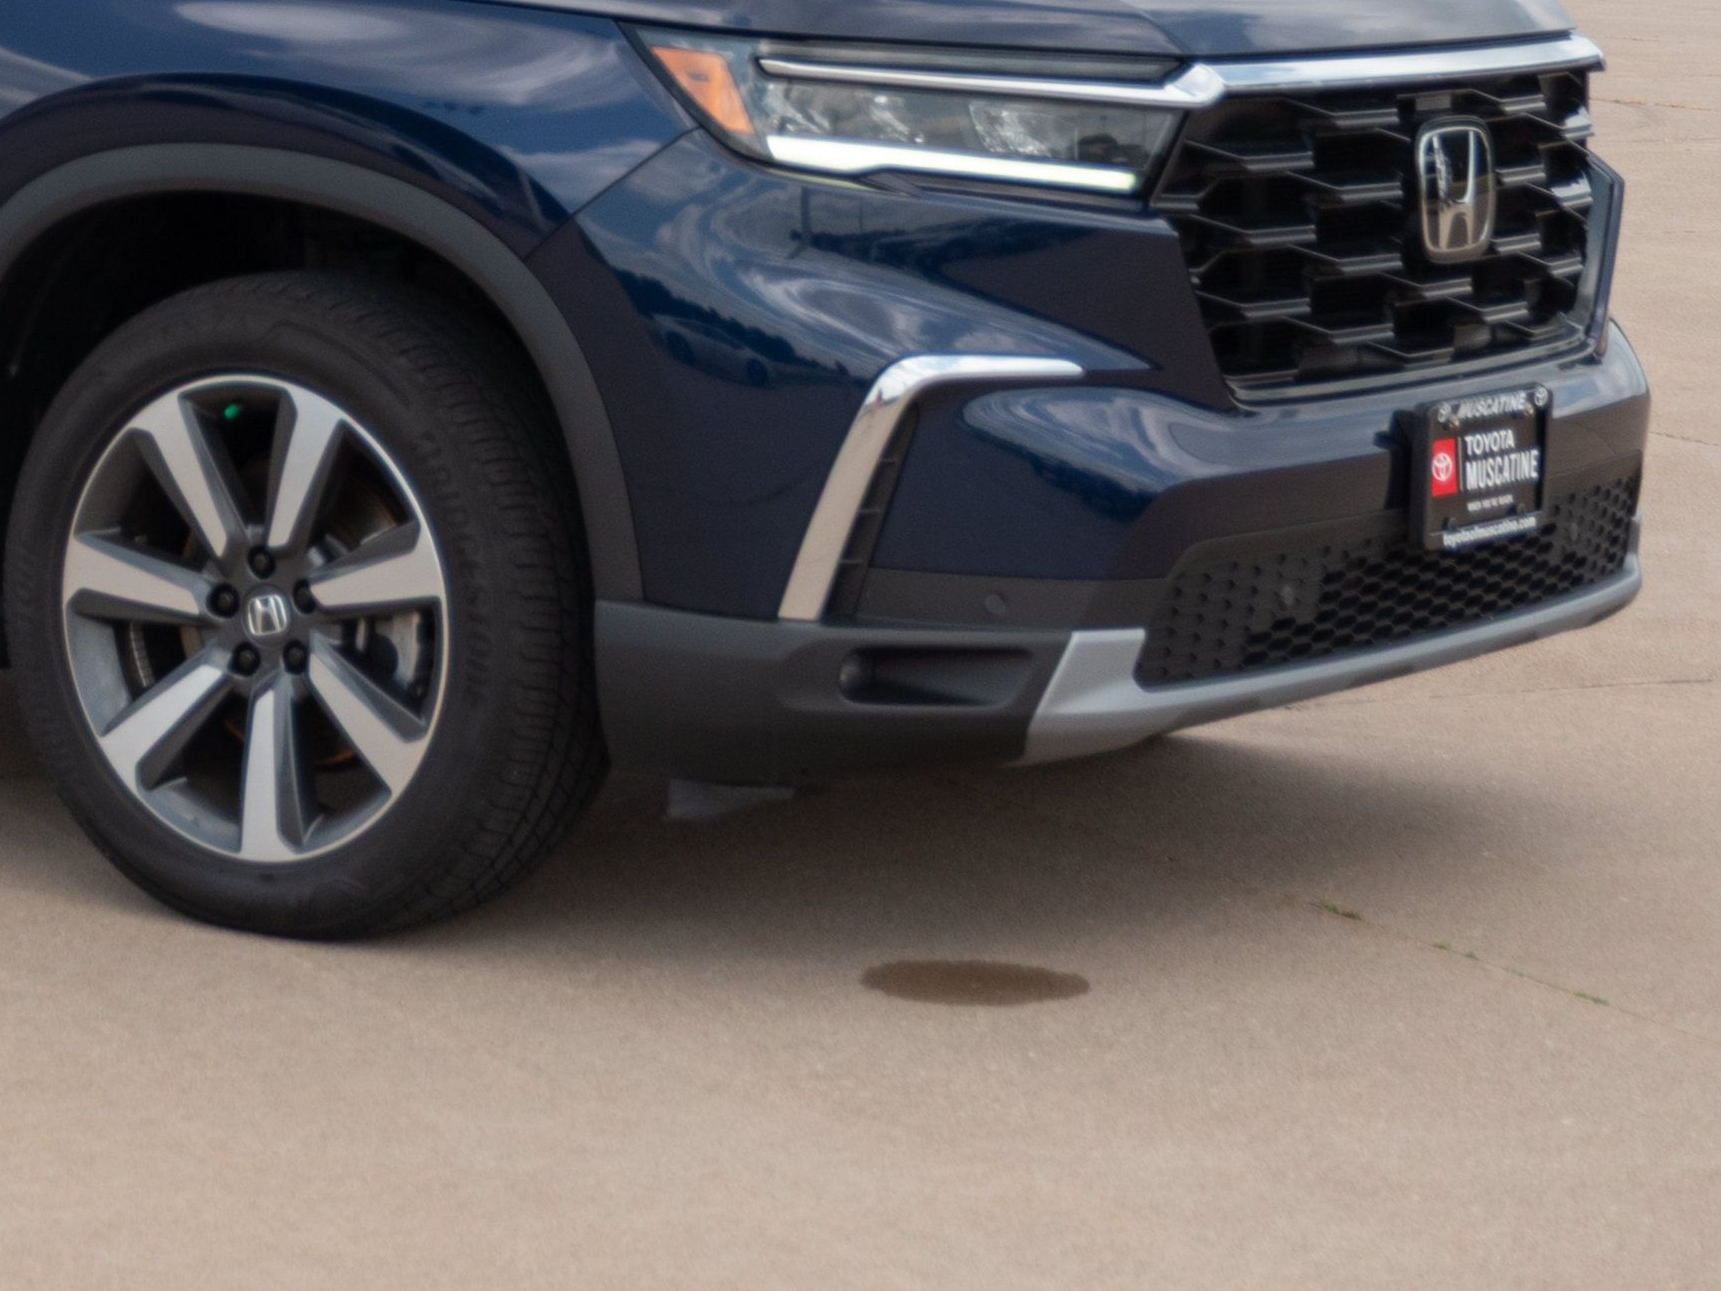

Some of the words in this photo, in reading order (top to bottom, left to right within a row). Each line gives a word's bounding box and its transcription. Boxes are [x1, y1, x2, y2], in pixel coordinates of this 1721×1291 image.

[1458, 391, 1527, 418] MUSCATINE
[1464, 429, 1515, 455] TOYOTA
[1465, 449, 1539, 491] MUSCATINE
